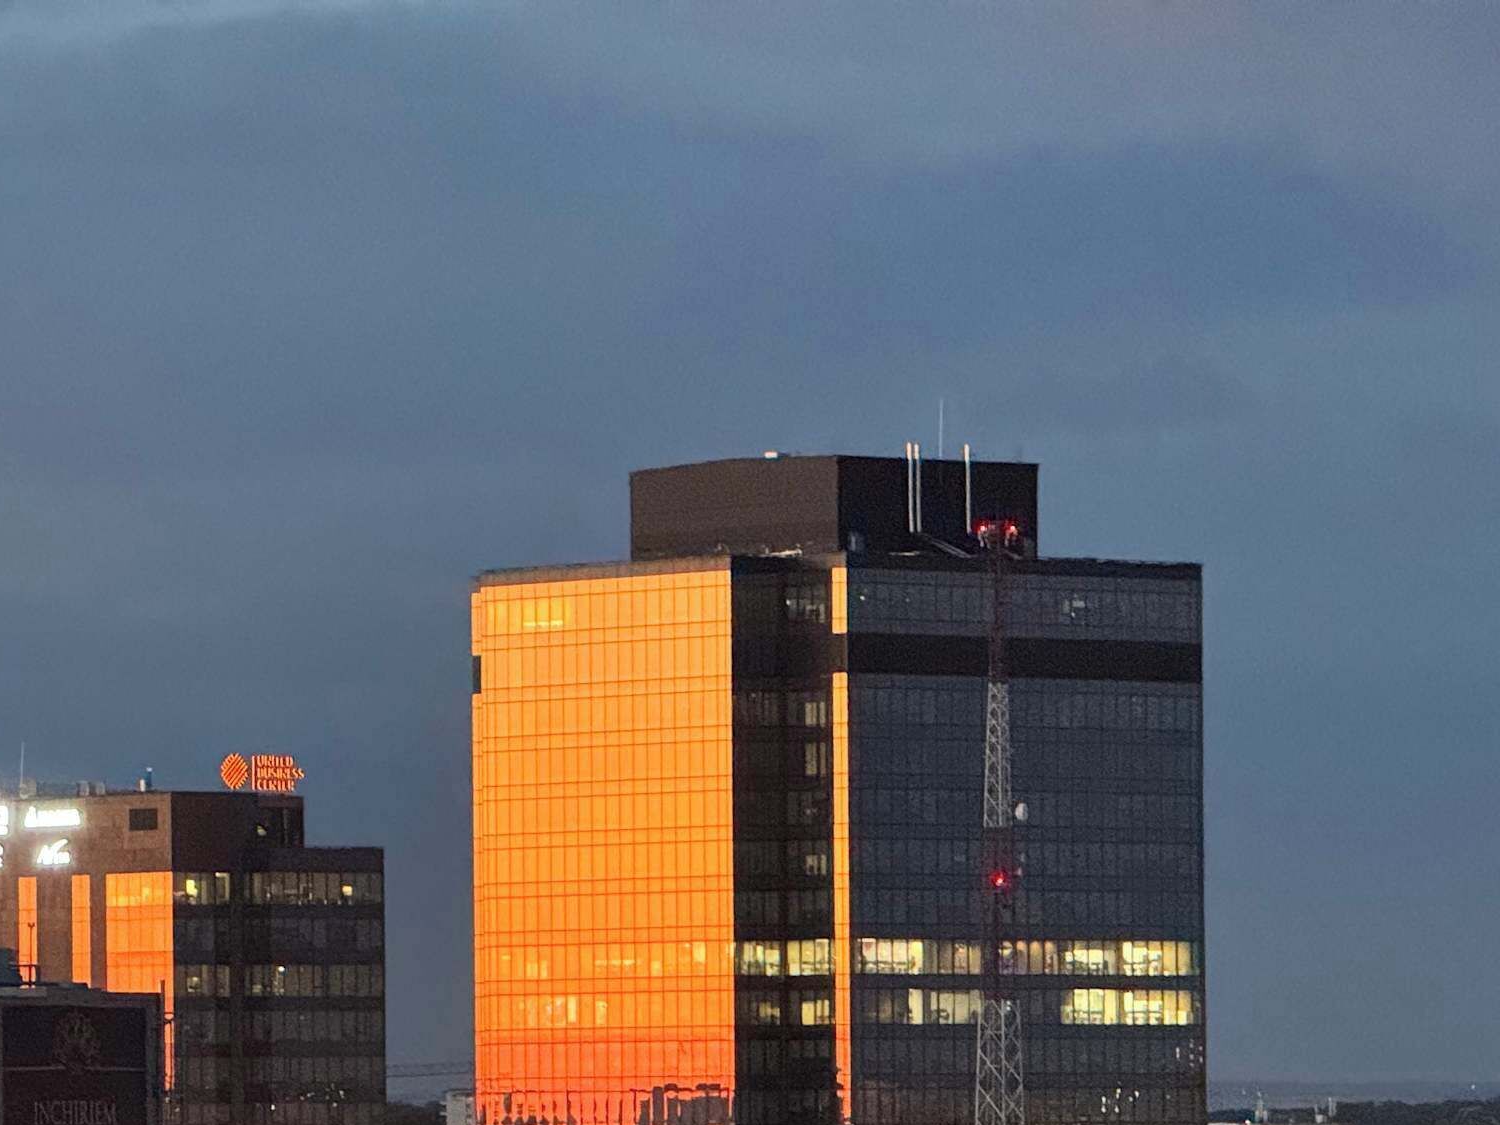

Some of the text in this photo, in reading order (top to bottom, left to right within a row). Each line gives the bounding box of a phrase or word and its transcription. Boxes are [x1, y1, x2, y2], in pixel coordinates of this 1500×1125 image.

[257, 754, 294, 767] UNITED
[257, 767, 305, 779] BUSINESS
[257, 779, 295, 791] CENTER
[33, 1100, 118, 1125] INCHIRIEM
